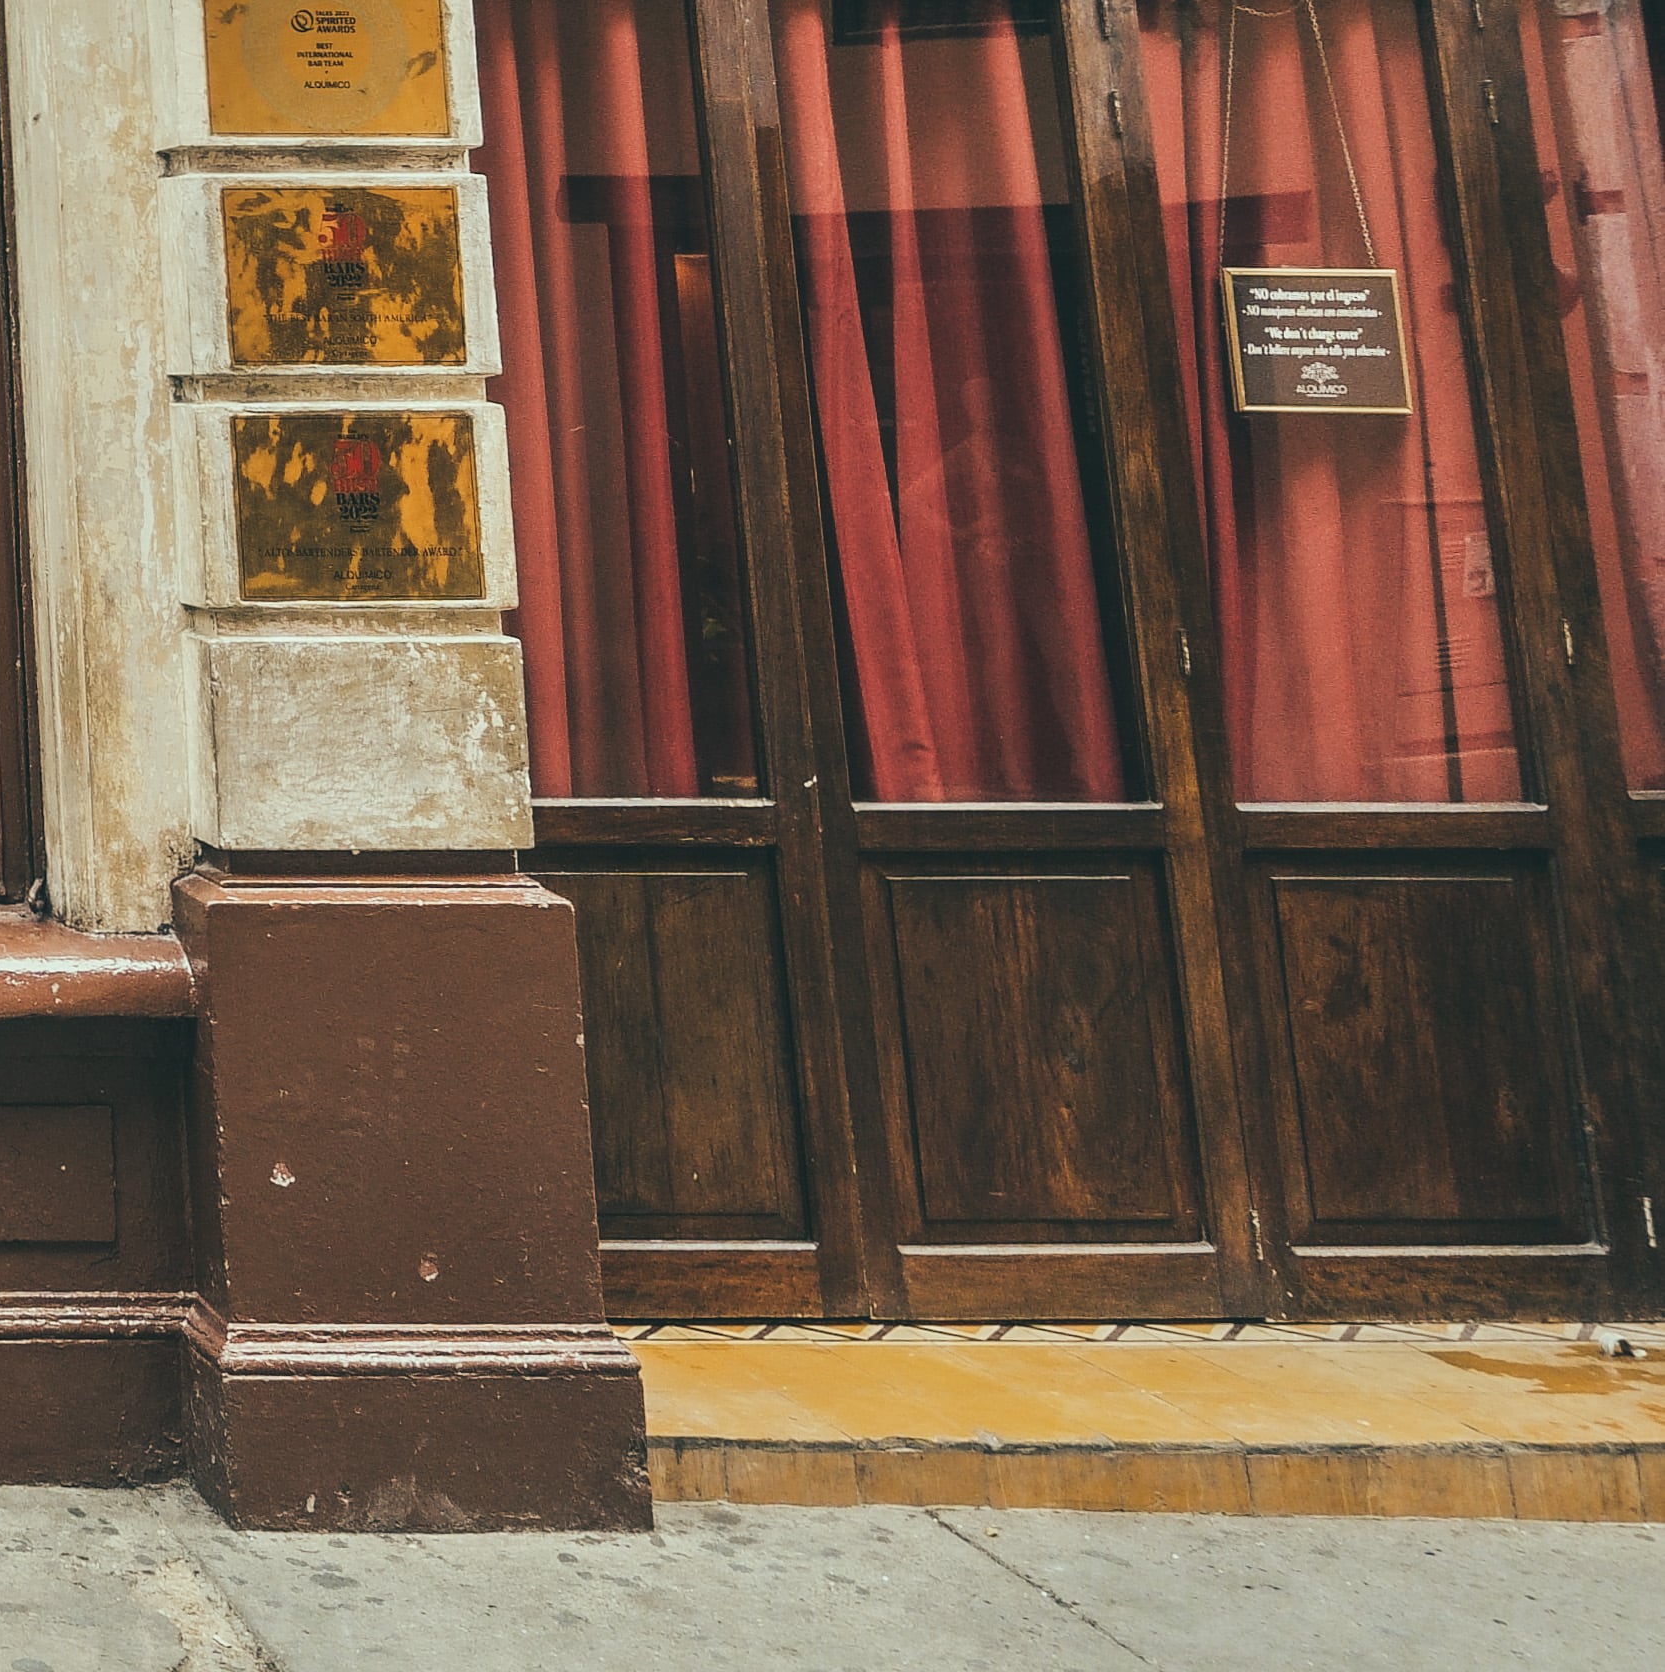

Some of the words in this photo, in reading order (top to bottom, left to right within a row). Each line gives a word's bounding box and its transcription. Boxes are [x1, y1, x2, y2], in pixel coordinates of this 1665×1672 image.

[315, 17, 356, 25] SPIRITED
[317, 214, 367, 248] 50
[323, 262, 365, 274] BARS
[331, 440, 381, 479] 50
[336, 492, 381, 505] BARS
[339, 504, 379, 519] 2022
